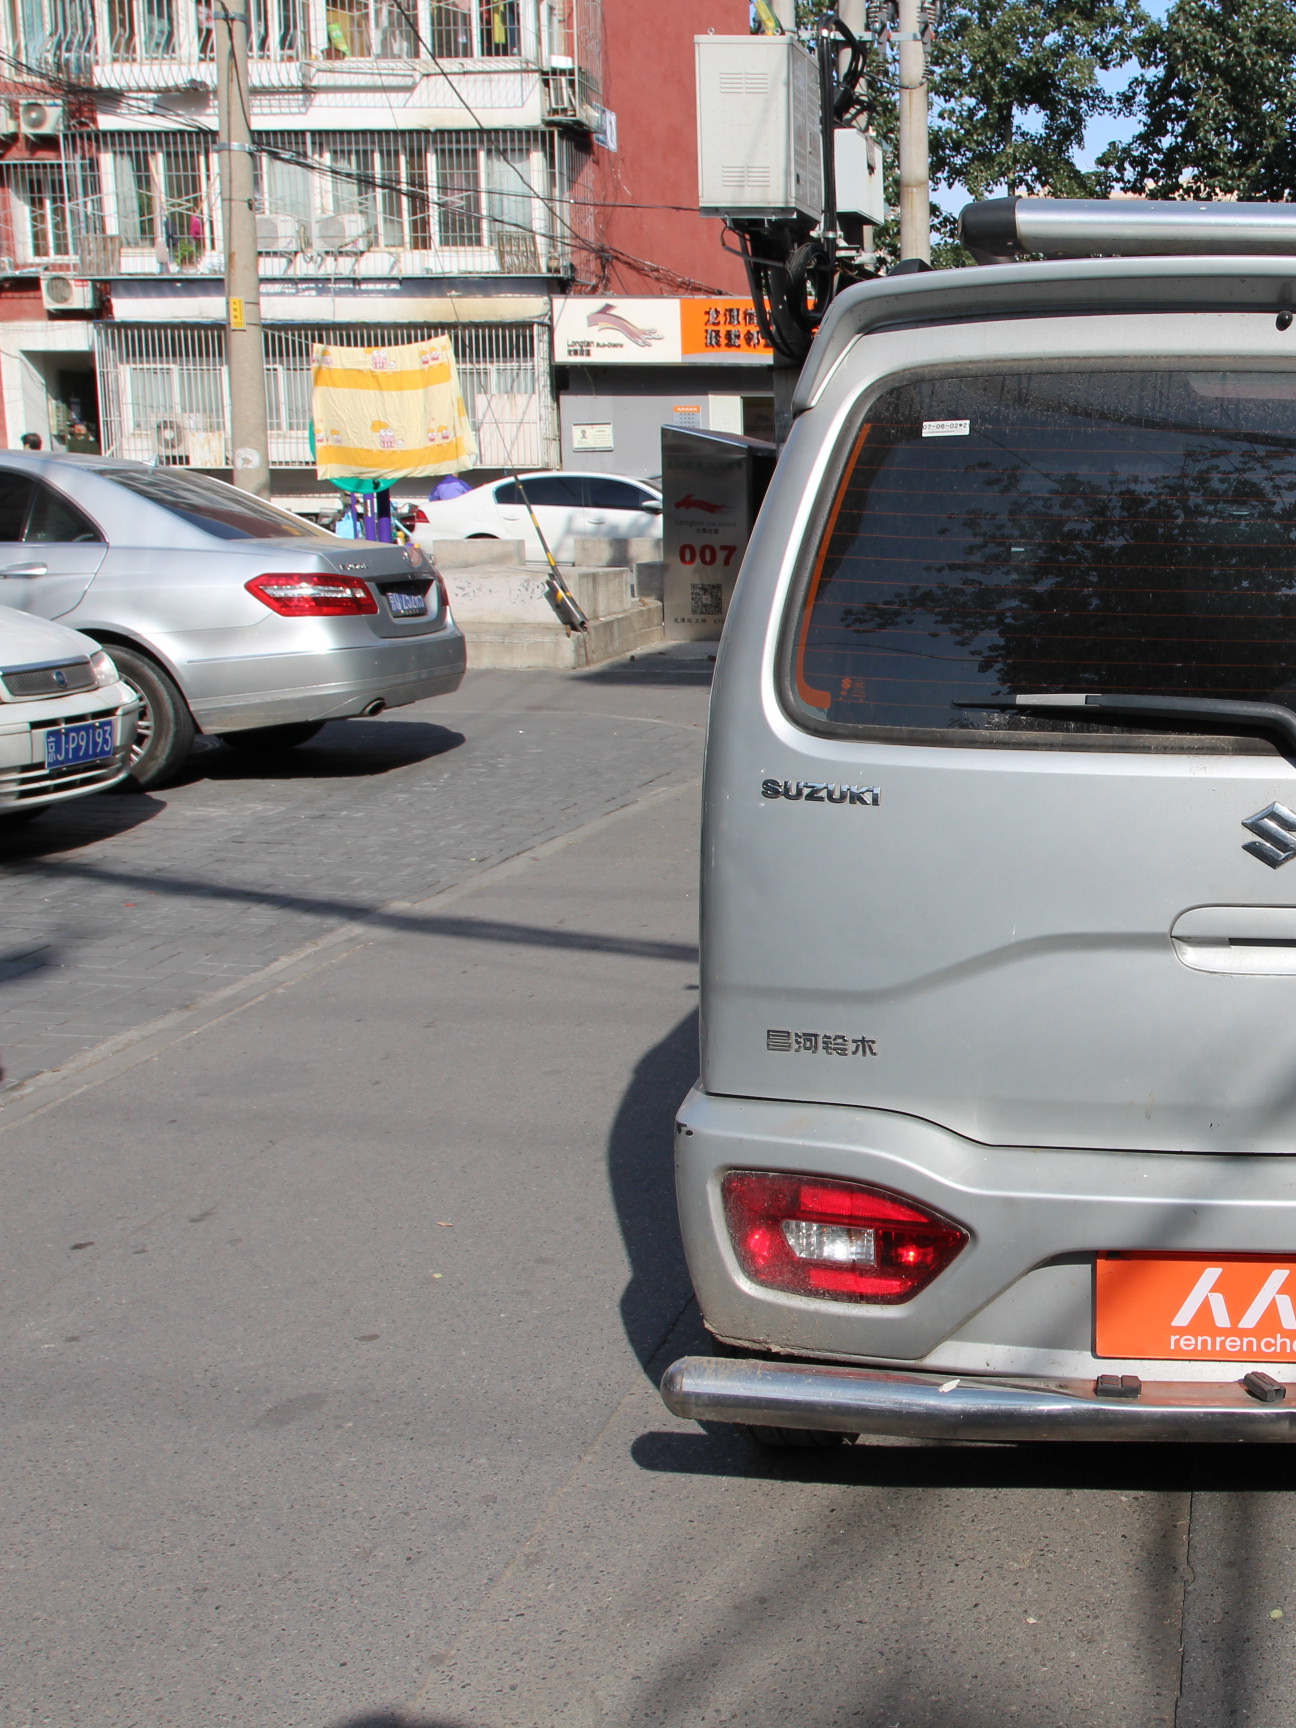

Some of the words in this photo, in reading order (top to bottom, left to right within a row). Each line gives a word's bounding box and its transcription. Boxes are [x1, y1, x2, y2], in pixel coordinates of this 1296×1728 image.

[679, 543, 737, 566] 007
[761, 779, 881, 806] SUZUKI
[766, 1029, 878, 1057] 昌河铃木
